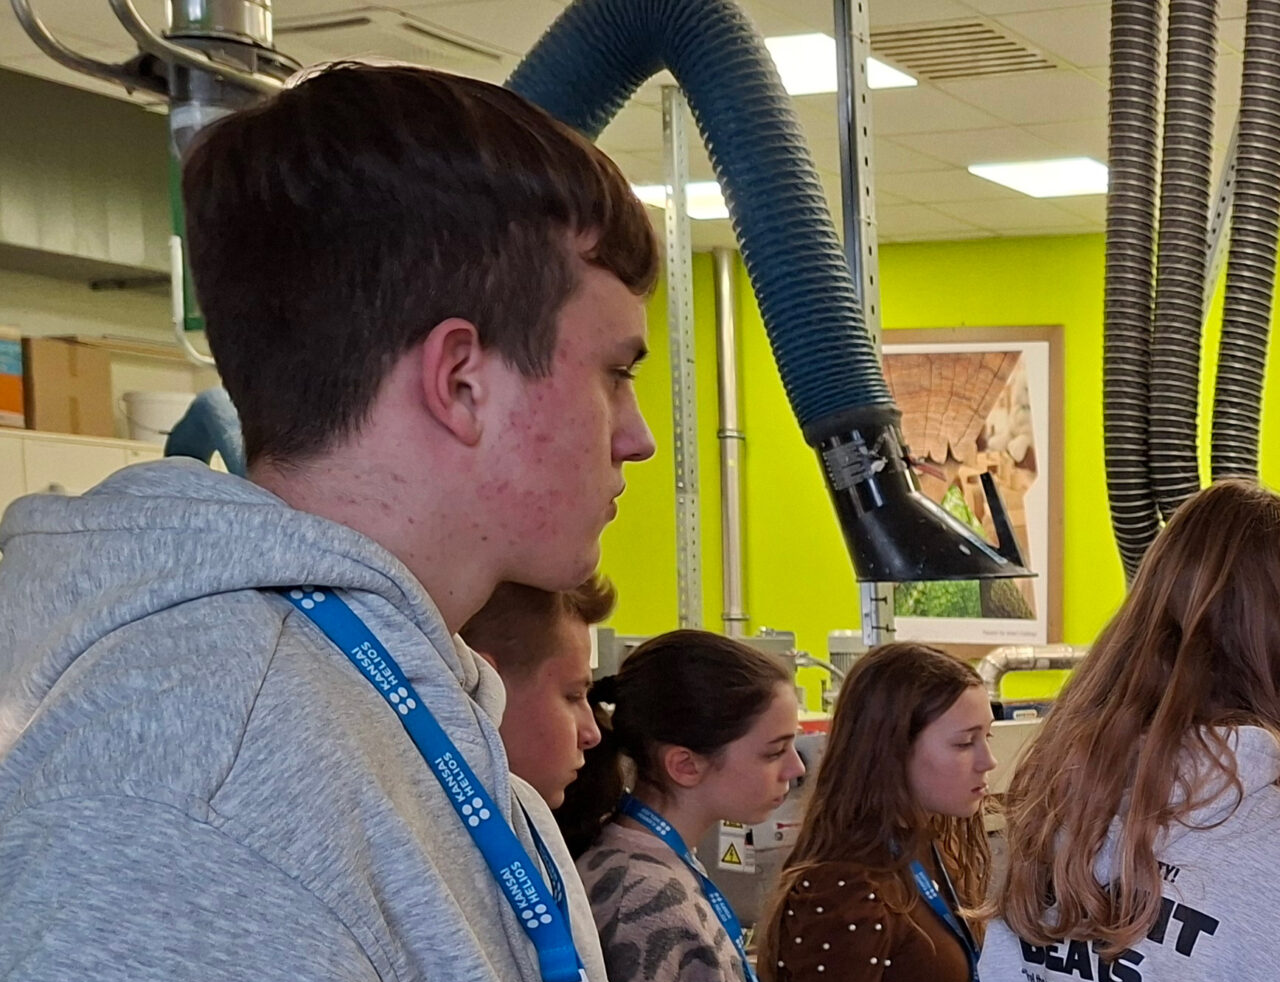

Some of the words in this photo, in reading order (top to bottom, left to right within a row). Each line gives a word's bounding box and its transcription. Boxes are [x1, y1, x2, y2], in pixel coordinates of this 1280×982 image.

[351, 646, 391, 692] KANSAI
[360, 640, 399, 688] HELIOS
[434, 757, 465, 803] KANSAI
[443, 751, 475, 797] HELIOS
[500, 867, 528, 910] KANSAI
[510, 860, 539, 904] HELIOS
